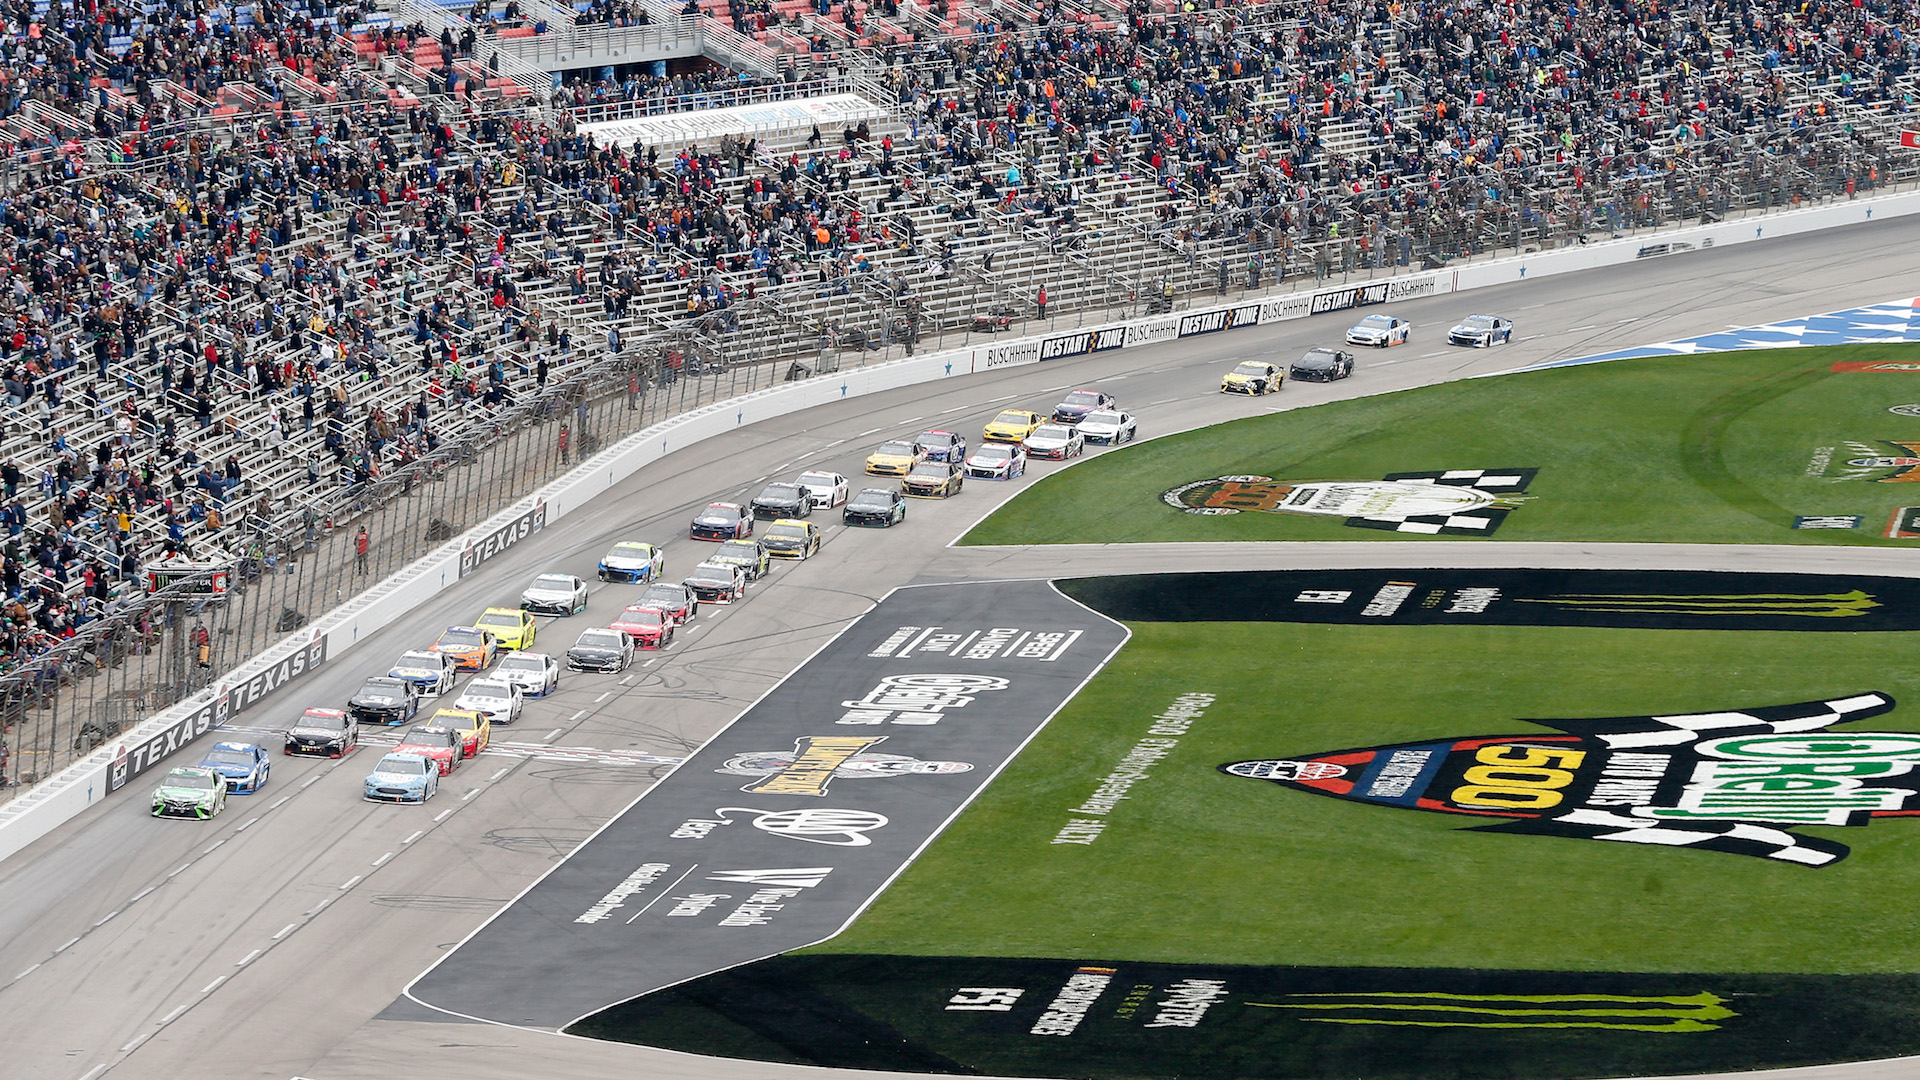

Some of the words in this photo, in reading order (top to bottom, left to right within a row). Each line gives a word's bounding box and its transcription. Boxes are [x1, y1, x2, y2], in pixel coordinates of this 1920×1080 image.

[826, 99, 869, 112] TEXAS
[600, 125, 642, 138] TEXAS
[1314, 290, 1356, 312] RESTART
[1363, 286, 1389, 303] ZONE
[1181, 311, 1226, 335] RESTART
[1233, 307, 1259, 327] ZONE
[1042, 333, 1091, 358] RESTART
[1096, 329, 1124, 349] ZONE
[474, 516, 530, 566] TEXAS
[918, 633, 963, 652] FUN!
[962, 627, 1020, 660] DANGER
[1016, 632, 1066, 658] SPEED
[234, 650, 305, 711] TEXAS
[840, 673, 1010, 713] O'Reilly
[133, 707, 212, 774] TEXAS
[1450, 745, 1587, 810] 500
[1601, 752, 1672, 778] AUTO
[1585, 778, 1661, 806] PARTS
[669, 818, 734, 840] Texas
[666, 893, 732, 917] System
[744, 887, 803, 904] Wise
[716, 903, 786, 926] Health
[944, 986, 1026, 1012] FS1
[1112, 984, 1153, 1020] ENERGY
[1143, 978, 1230, 1028] MONSTER
